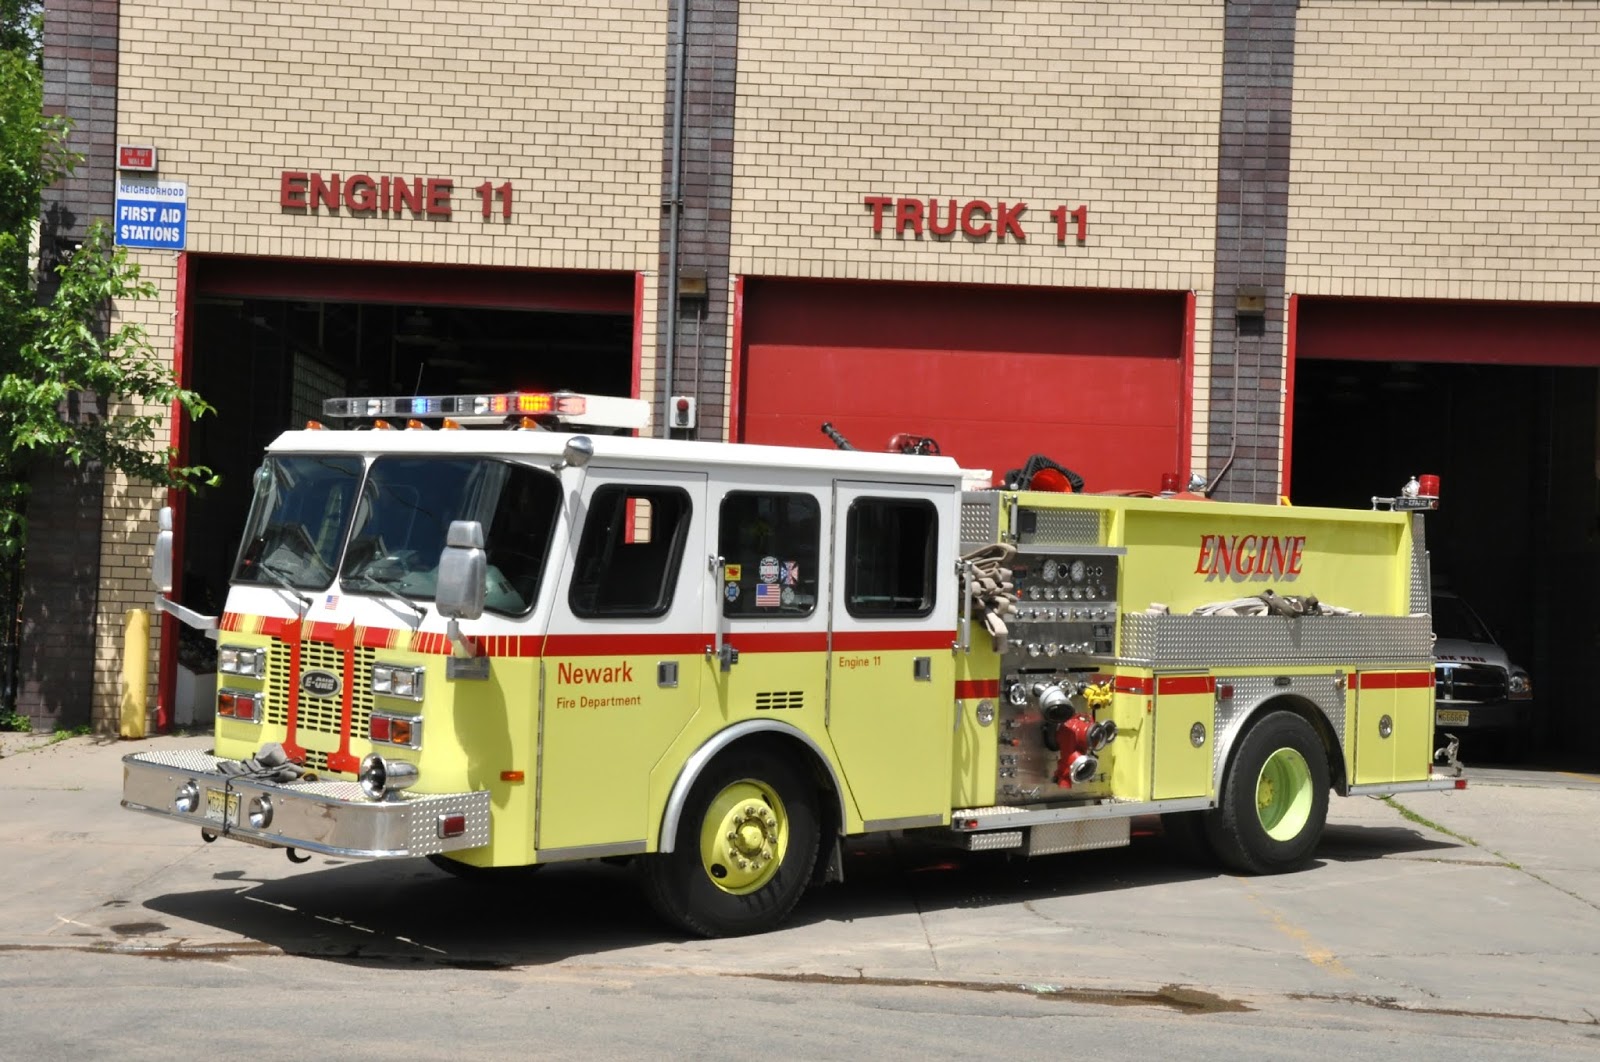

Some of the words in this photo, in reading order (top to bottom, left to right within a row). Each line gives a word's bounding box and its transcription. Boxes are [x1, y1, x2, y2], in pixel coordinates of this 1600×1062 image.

[120, 184, 184, 197] NEIGHBORHOOD
[281, 171, 453, 214] ENGINE
[475, 181, 513, 218] 11
[121, 206, 156, 222] FIRST
[160, 208, 181, 223] AID
[864, 195, 1028, 240] TRUCK
[1050, 205, 1087, 241] 11
[121, 225, 180, 242] STATIONS
[1194, 534, 1306, 575] ENGINE
[839, 656, 869, 669] Engine
[873, 656, 881, 666] 11
[558, 661, 633, 685] Newark
[556, 697, 576, 709] Fire
[580, 695, 641, 709] Department
